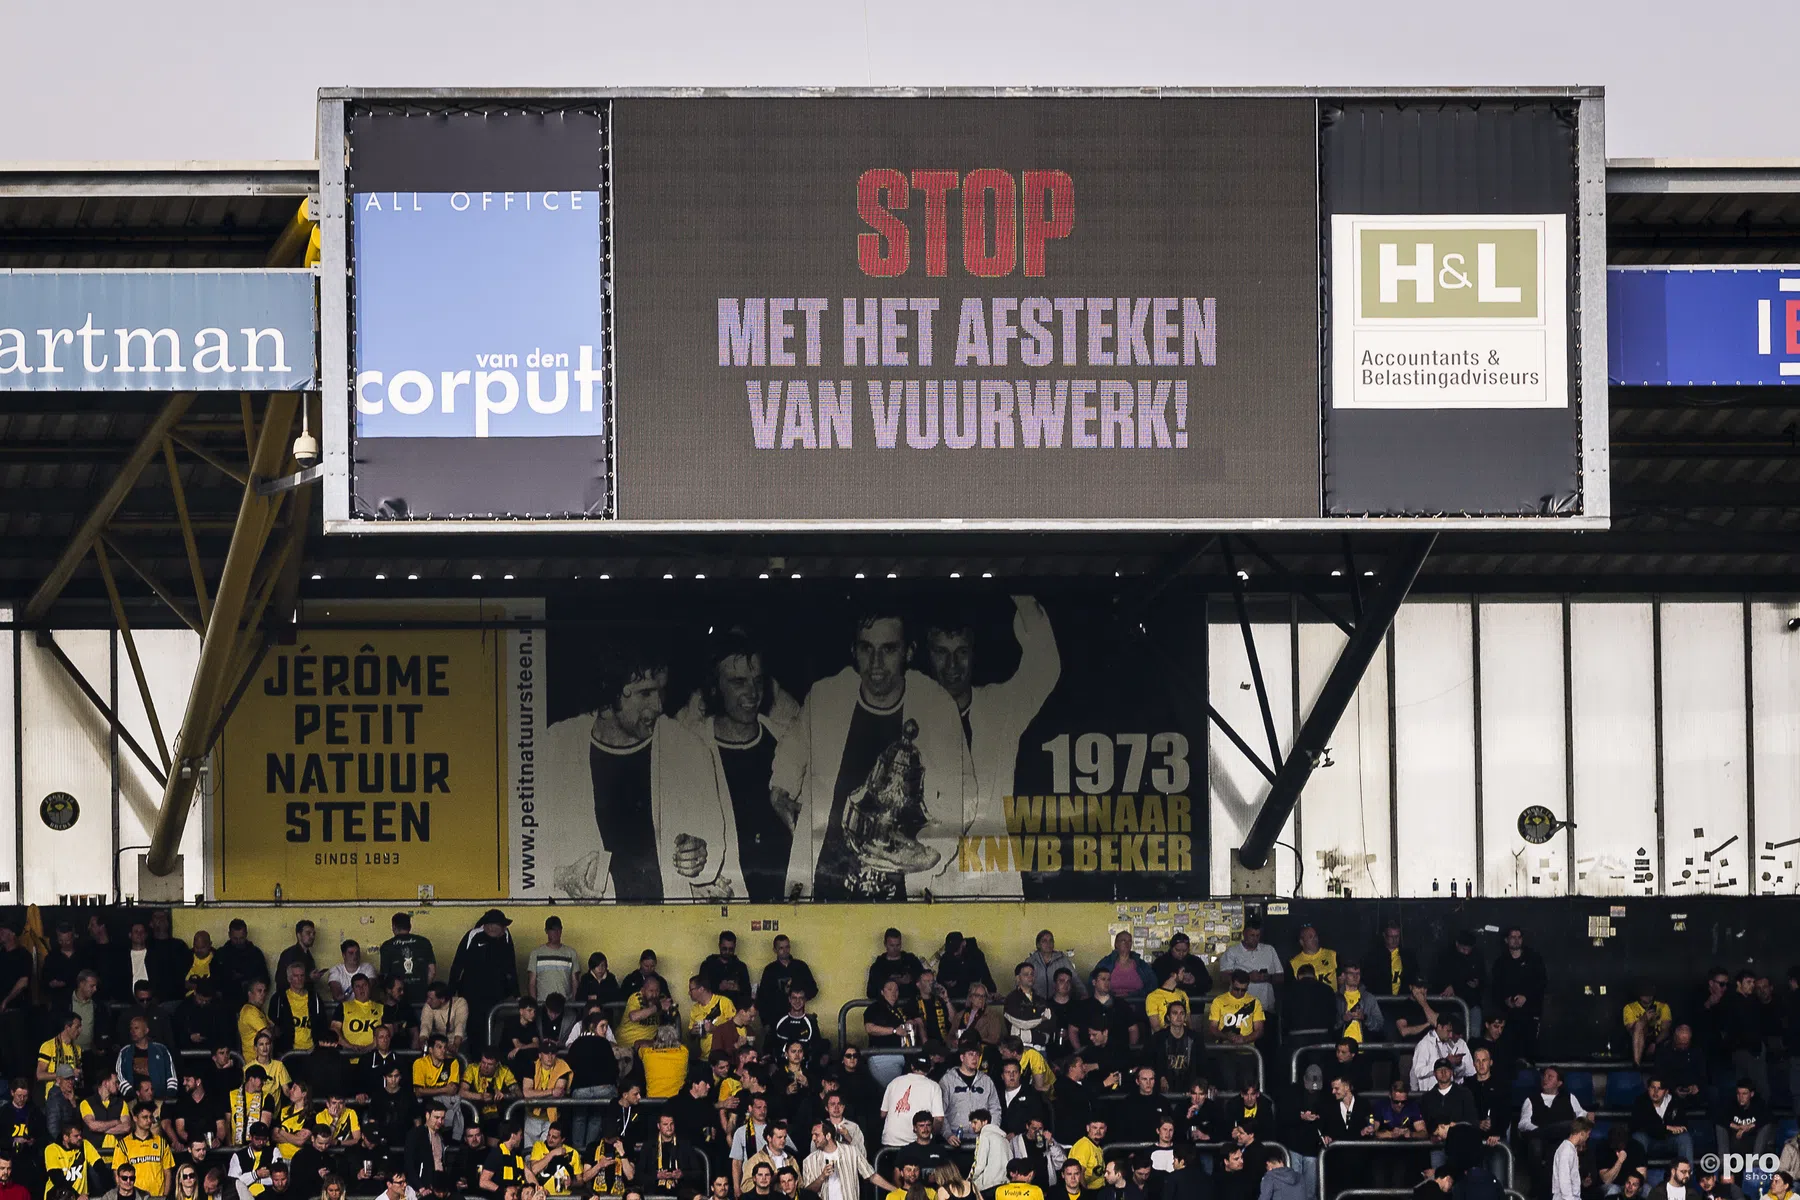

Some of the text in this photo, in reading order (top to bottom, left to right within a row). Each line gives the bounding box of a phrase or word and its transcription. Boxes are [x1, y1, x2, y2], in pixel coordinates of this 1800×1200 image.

[364, 191, 583, 212] ALL OFFICE
[857, 168, 1075, 278] STOP
[1379, 242, 1522, 303] H&L
[717, 296, 1218, 366] MET HET AFSTEKEN
[475, 347, 569, 368] van den
[1361, 349, 1500, 366] Accountants &
[356, 345, 602, 438] corput
[1361, 369, 1539, 389] Belastingadviseurs
[746, 379, 1189, 450] VAN VUURWERK!
[264, 643, 450, 696] JÉRÔME
[294, 704, 424, 745] PETIT
[266, 753, 451, 794] NATUUR
[1041, 732, 1190, 794] 1973
[286, 801, 431, 843] STEEN
[1003, 795, 1192, 833] WINNAAR
[315, 853, 358, 865] SINDS
[958, 834, 1192, 872] KNVB BEKER
[349, 1019, 378, 1033] OK
[1223, 1013, 1250, 1028] OK
